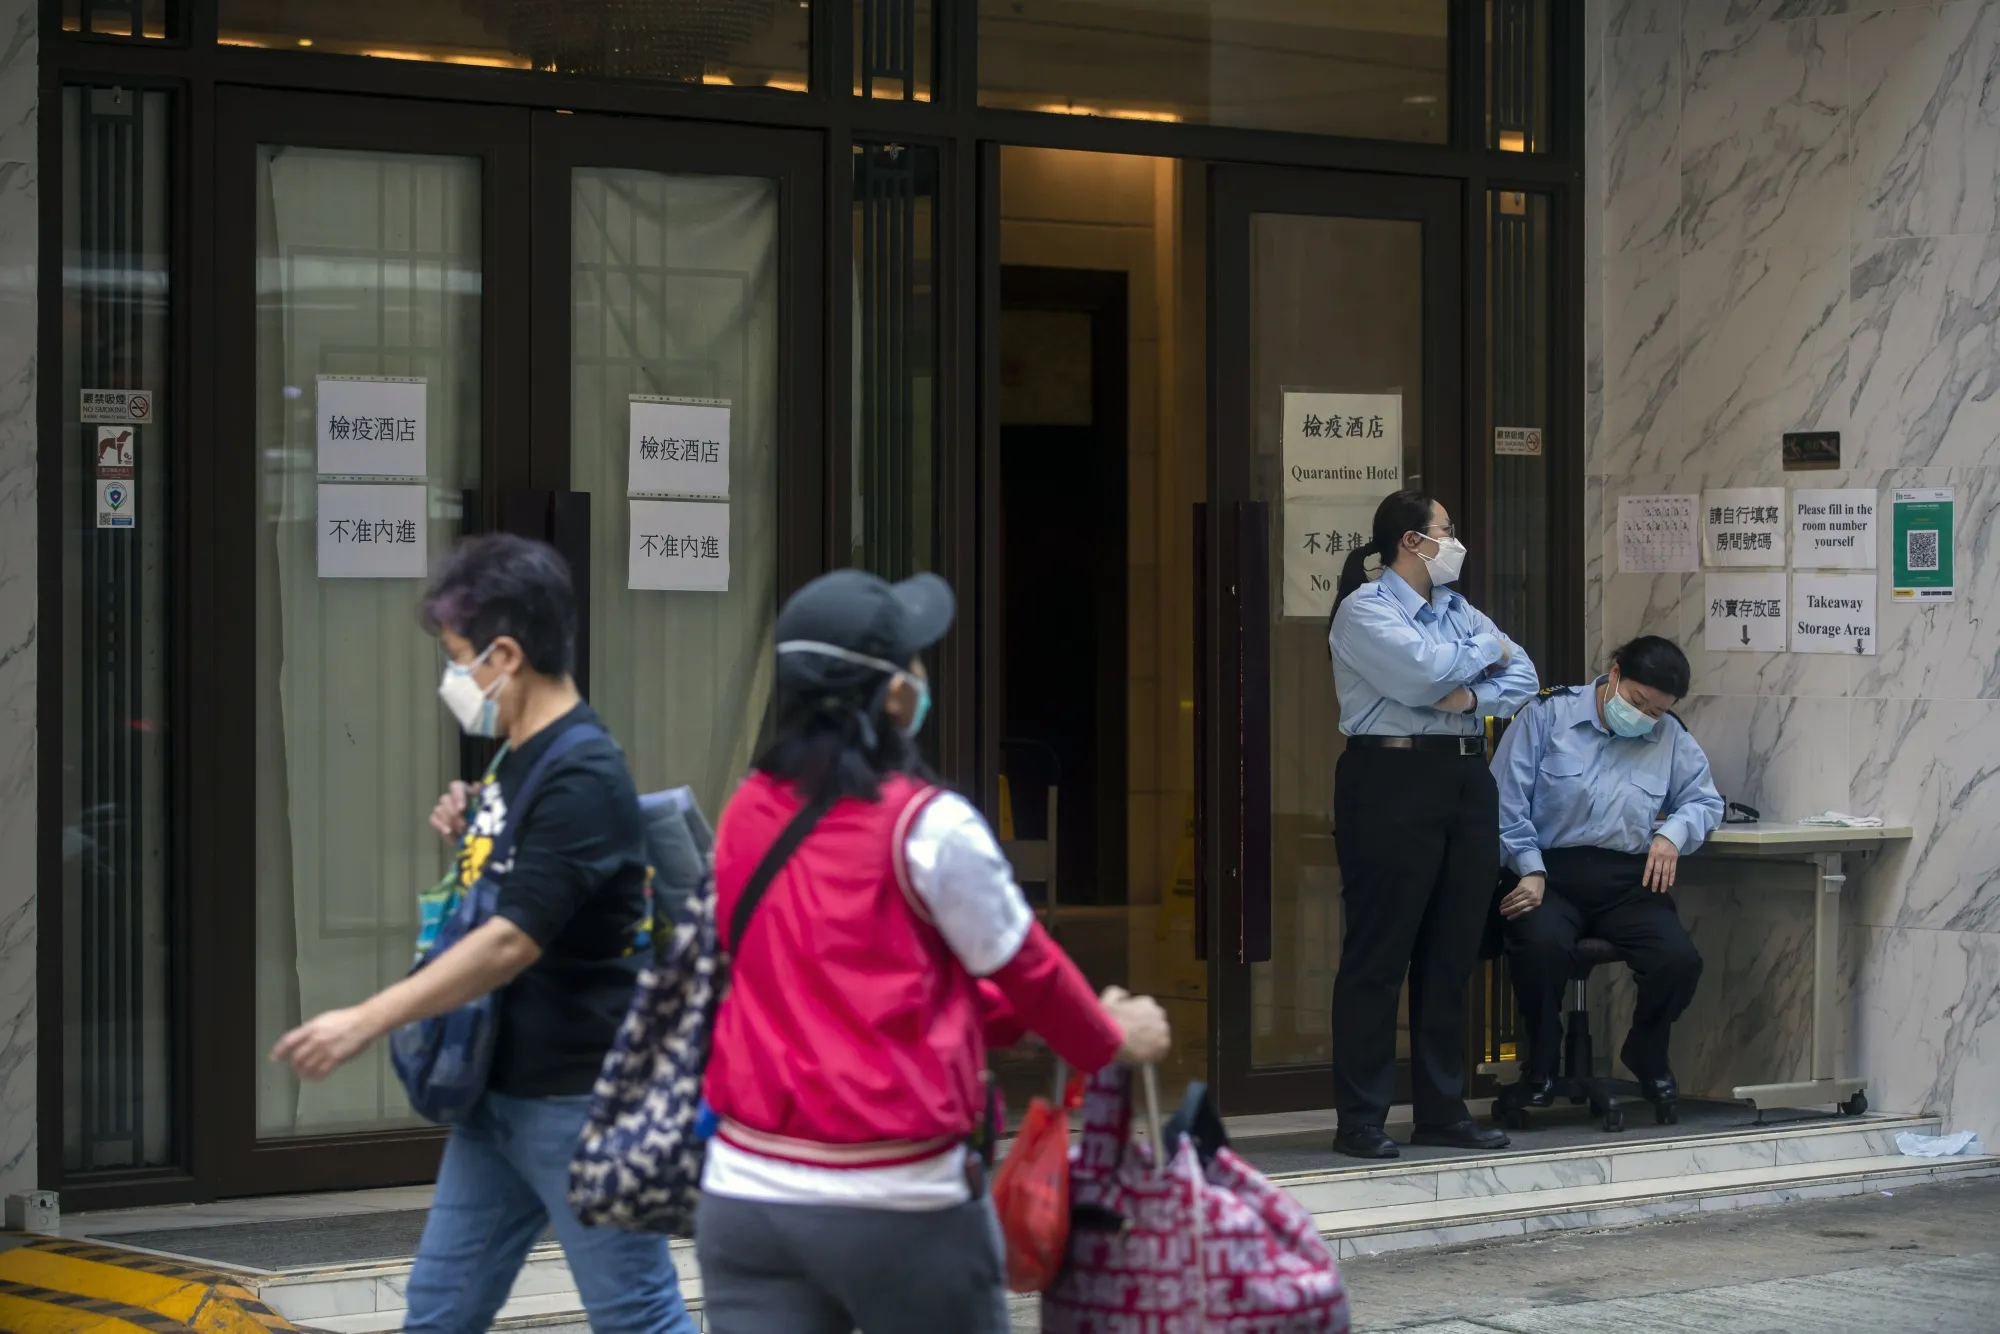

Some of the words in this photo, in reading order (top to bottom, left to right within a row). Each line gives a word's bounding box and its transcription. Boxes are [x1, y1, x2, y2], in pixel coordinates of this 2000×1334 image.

[83, 405, 94, 413] NO
[95, 406, 127, 414] SMOKING
[329, 415, 416, 442] 檢疫酒店
[1301, 413, 1384, 439] 檢疫酒店
[639, 435, 720, 464] 檢疫酒店
[1291, 465, 1363, 483] Quarantine
[1366, 465, 1398, 480] Hotel
[1709, 505, 1779, 525] 請自行填寫
[1798, 503, 1826, 515] Please
[1828, 503, 1842, 515] fill
[1844, 503, 1854, 515] in
[1856, 503, 1873, 515] the
[1802, 522, 1827, 531] room
[1829, 519, 1868, 531] number
[1716, 532, 1772, 551] 房間號碼
[1814, 535, 1855, 550] yourself
[1310, 574, 1331, 592] No
[1710, 598, 1781, 618] 外賣存放區
[1806, 595, 1863, 613] Takeaway
[1797, 621, 1841, 639] Storage
[1843, 623, 1871, 637] Area
